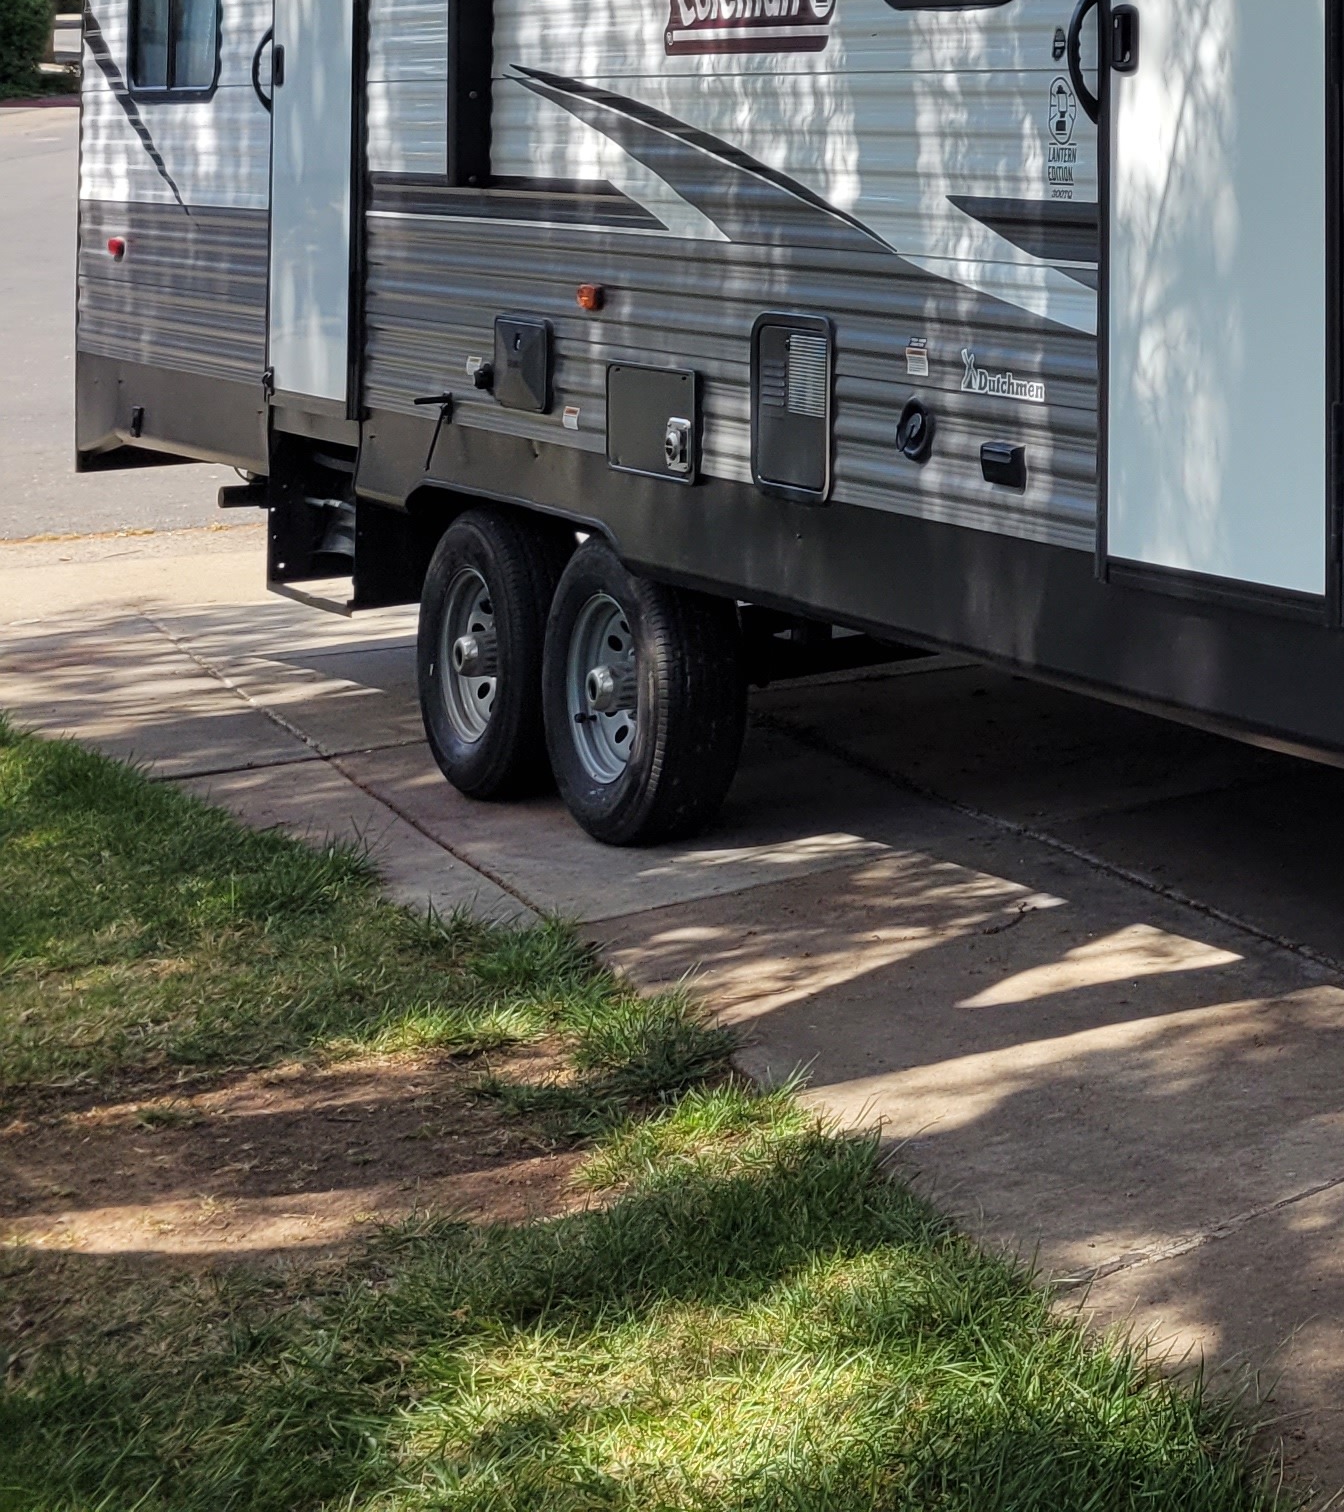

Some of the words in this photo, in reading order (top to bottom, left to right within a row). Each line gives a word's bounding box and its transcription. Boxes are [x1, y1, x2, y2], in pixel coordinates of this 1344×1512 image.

[1048, 147, 1077, 163] LANTERN
[1048, 166, 1073, 182] EDITION
[977, 370, 1044, 399] Dutchmen
